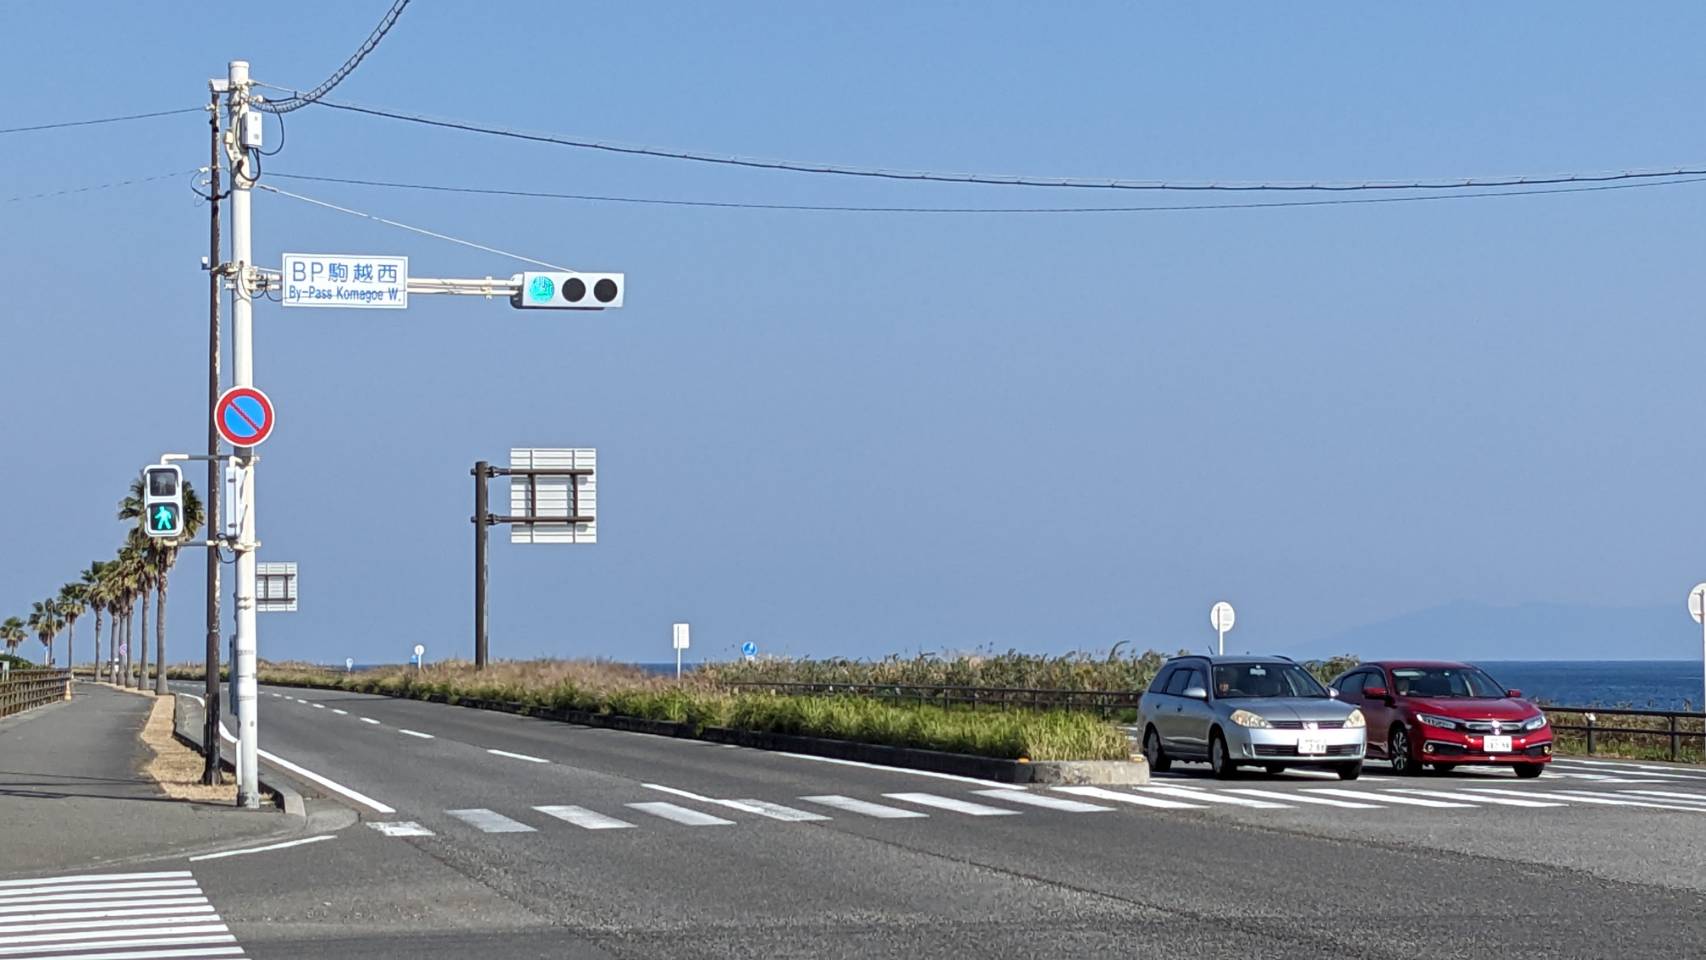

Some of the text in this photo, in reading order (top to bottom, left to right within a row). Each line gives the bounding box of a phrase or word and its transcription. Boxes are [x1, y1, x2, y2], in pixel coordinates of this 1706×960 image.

[293, 261, 398, 283] BP駒越西
[289, 285, 333, 302] By-Pass
[388, 287, 401, 302] W.
